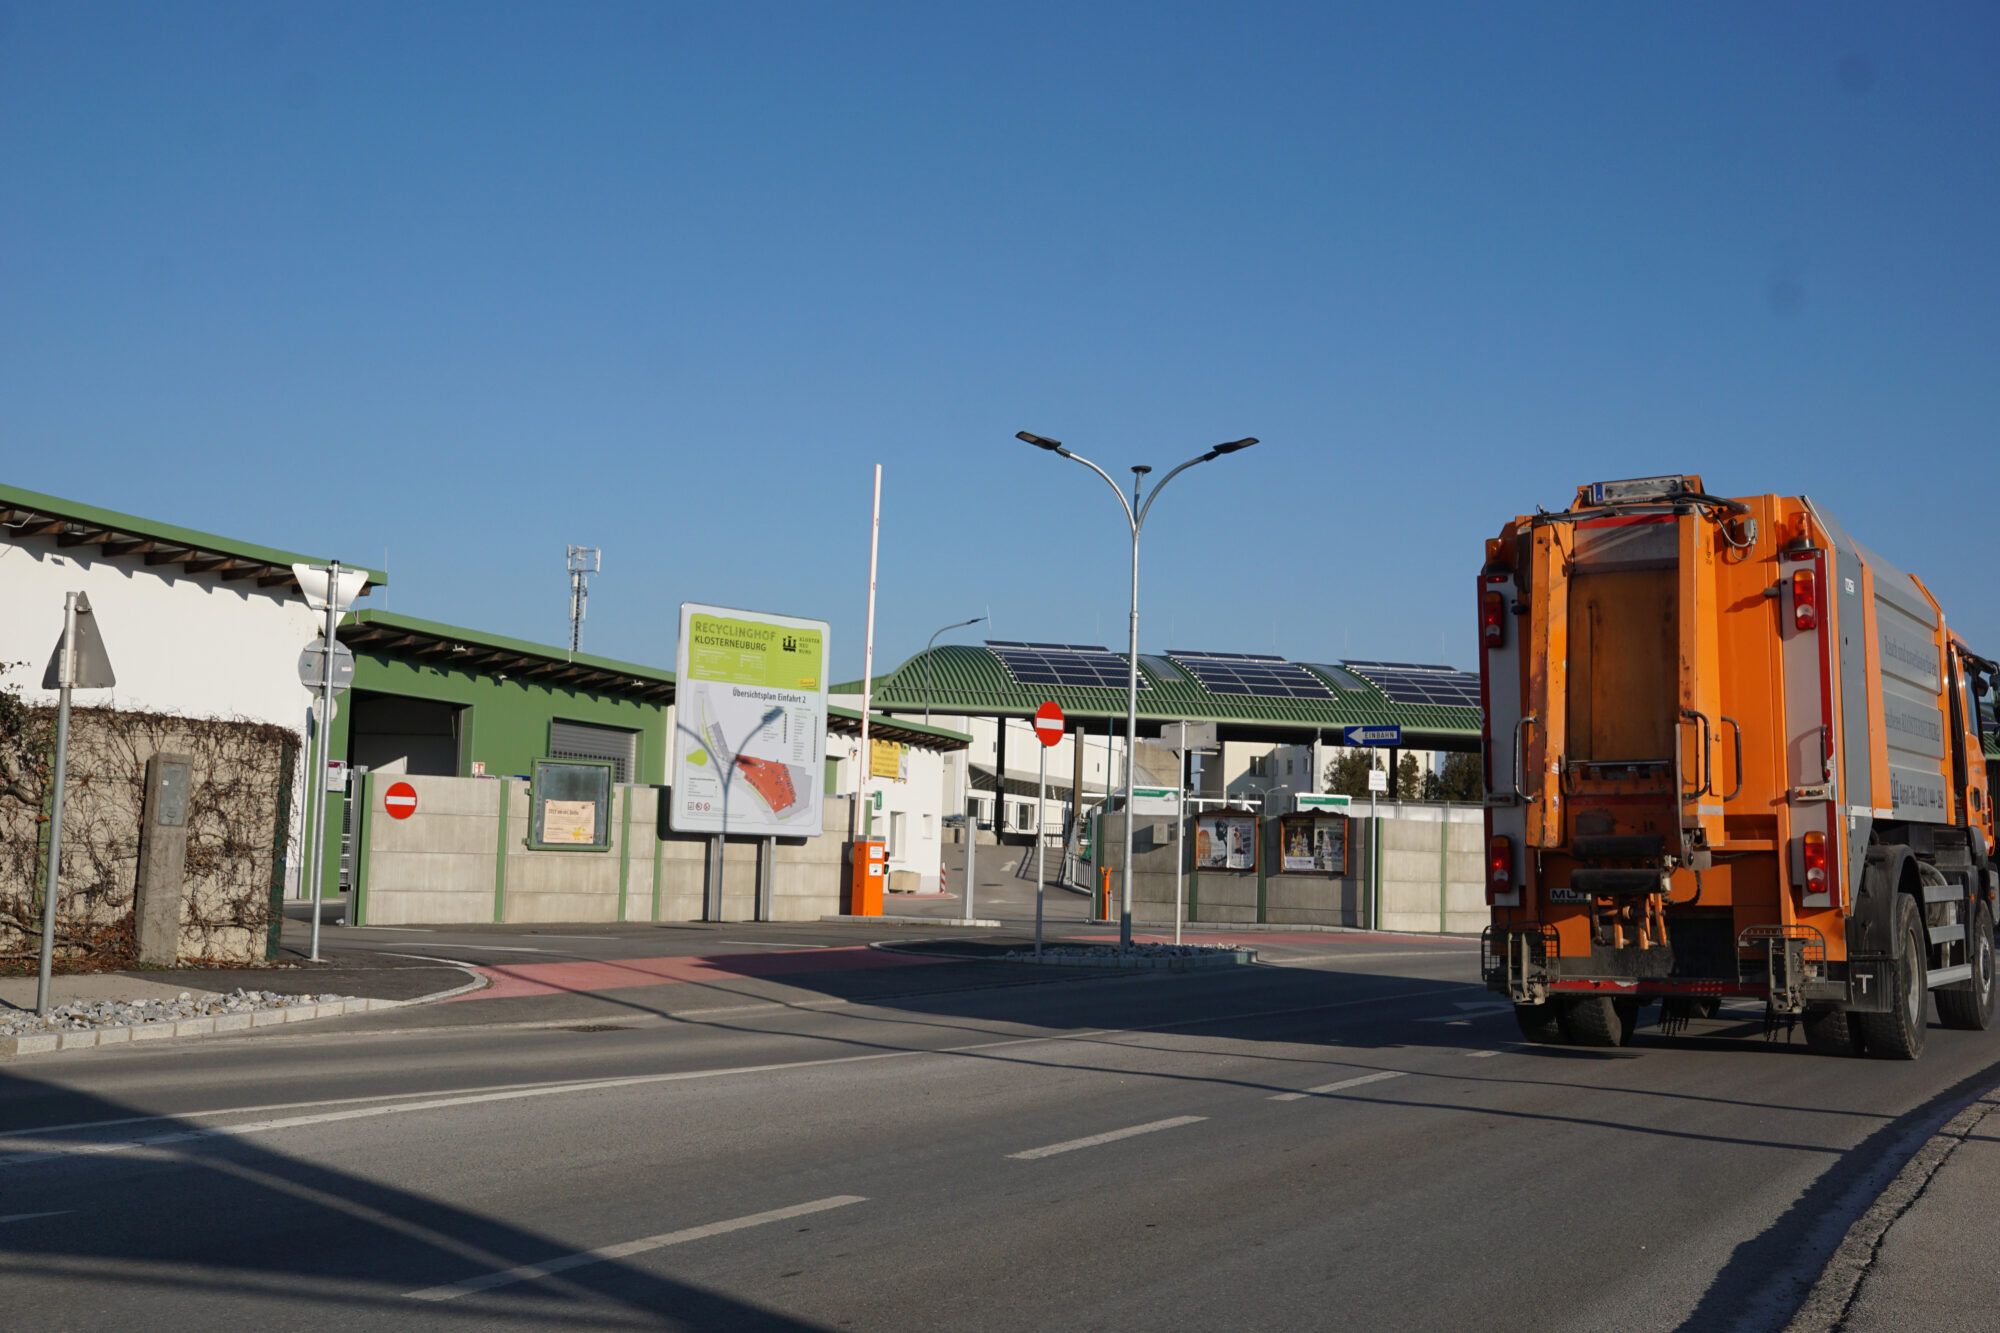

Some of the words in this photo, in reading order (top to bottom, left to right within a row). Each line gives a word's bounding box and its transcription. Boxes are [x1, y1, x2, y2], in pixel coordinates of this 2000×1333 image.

[695, 621, 777, 641] RECYCLINGHOF
[694, 635, 767, 652] KLOSTERNEUBURG
[732, 687, 777, 701] Übersichtsplan
[778, 692, 801, 704] Einfahrt
[802, 695, 806, 704] 2
[1364, 731, 1395, 739] EINBAHN
